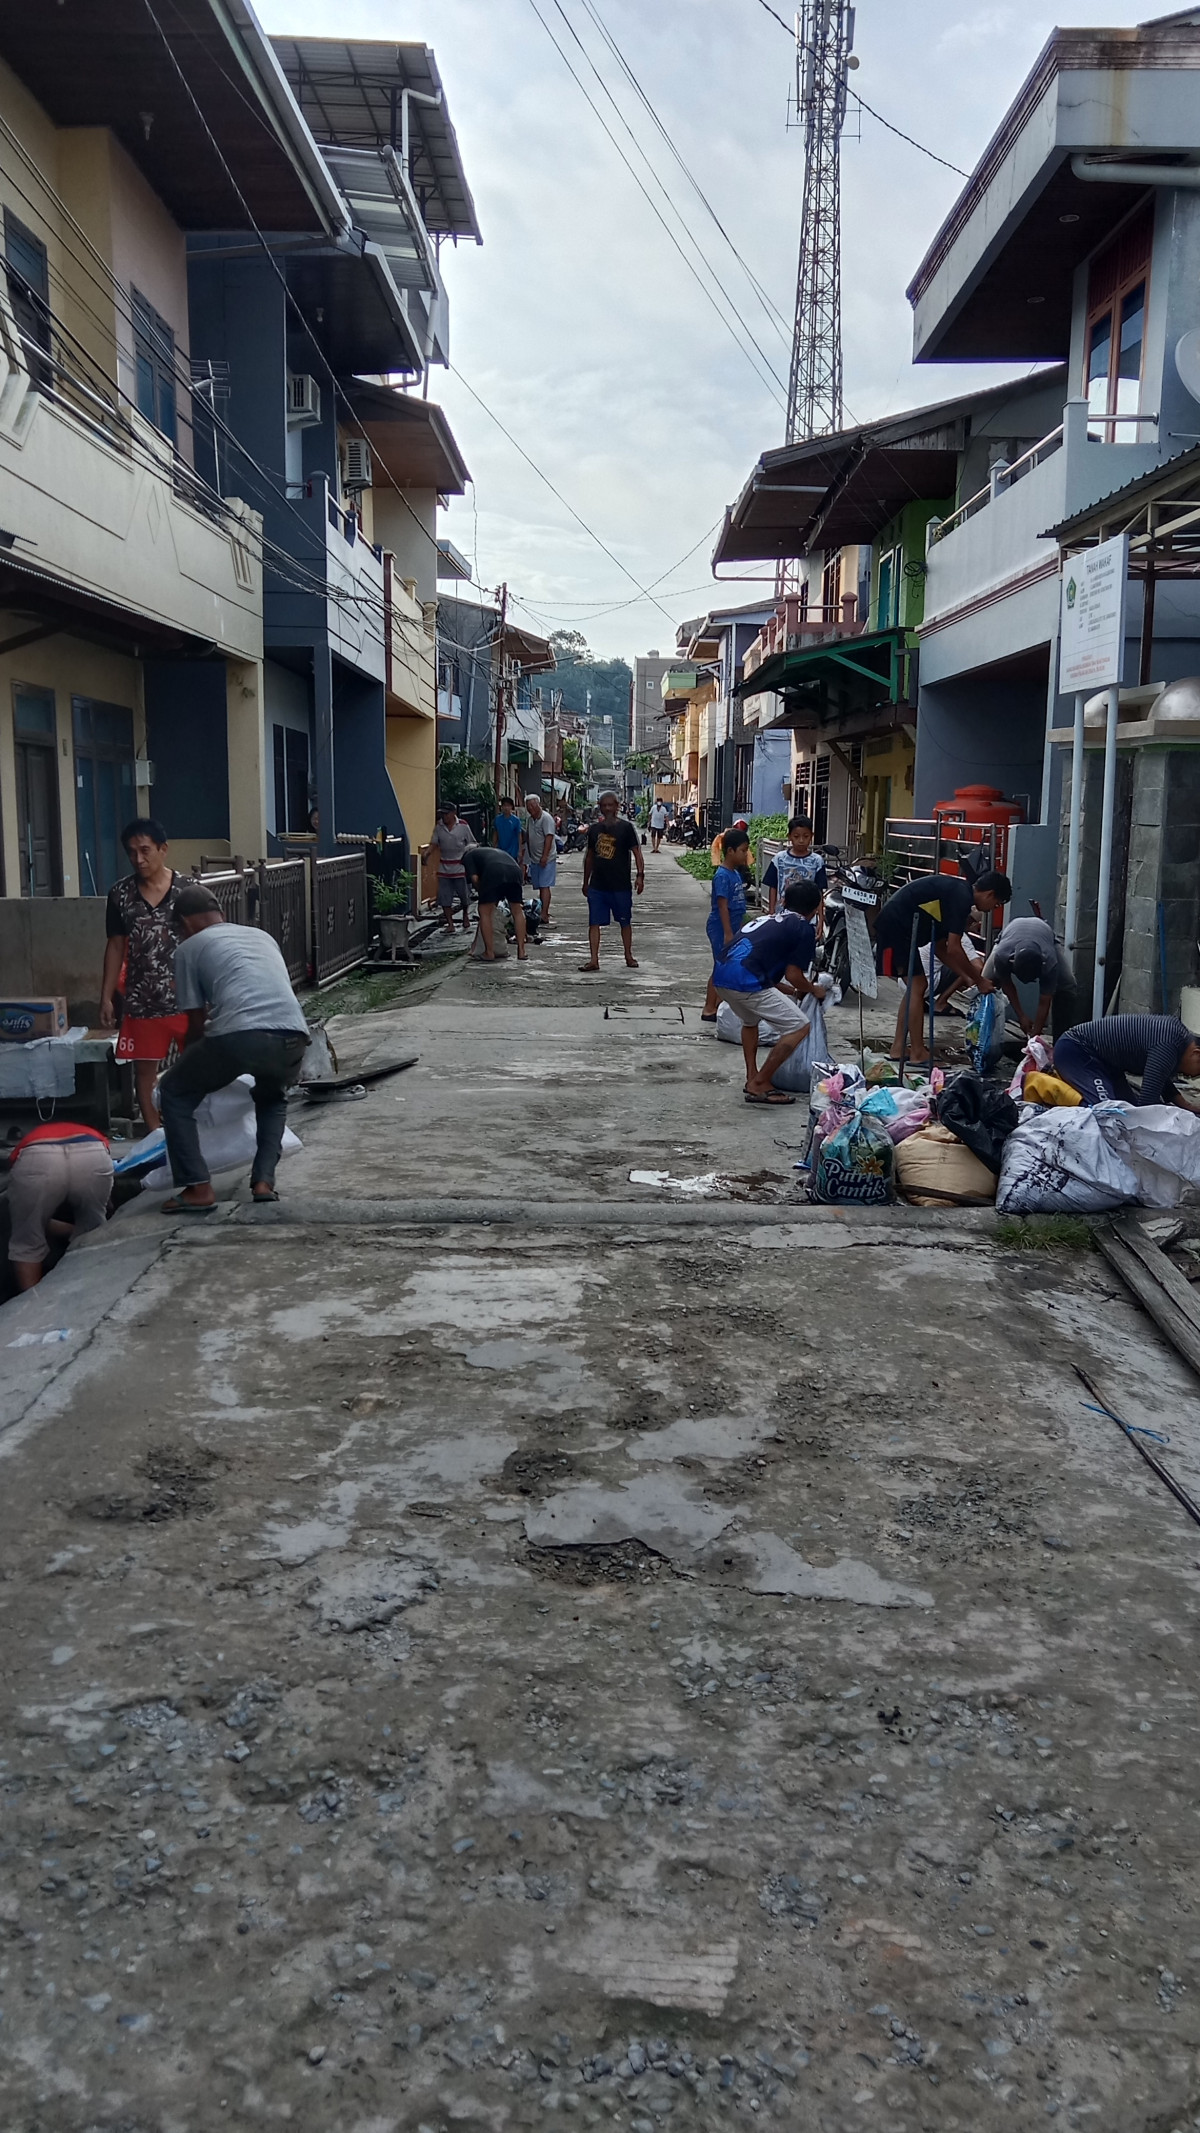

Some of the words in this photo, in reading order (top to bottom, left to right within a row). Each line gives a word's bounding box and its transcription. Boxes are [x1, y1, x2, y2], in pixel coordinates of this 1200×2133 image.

[119, 1037, 135, 1052] 66
[1093, 1078, 1110, 1101] adid
[825, 1160, 873, 1183] Putri
[827, 1178, 885, 1198] Cantik
